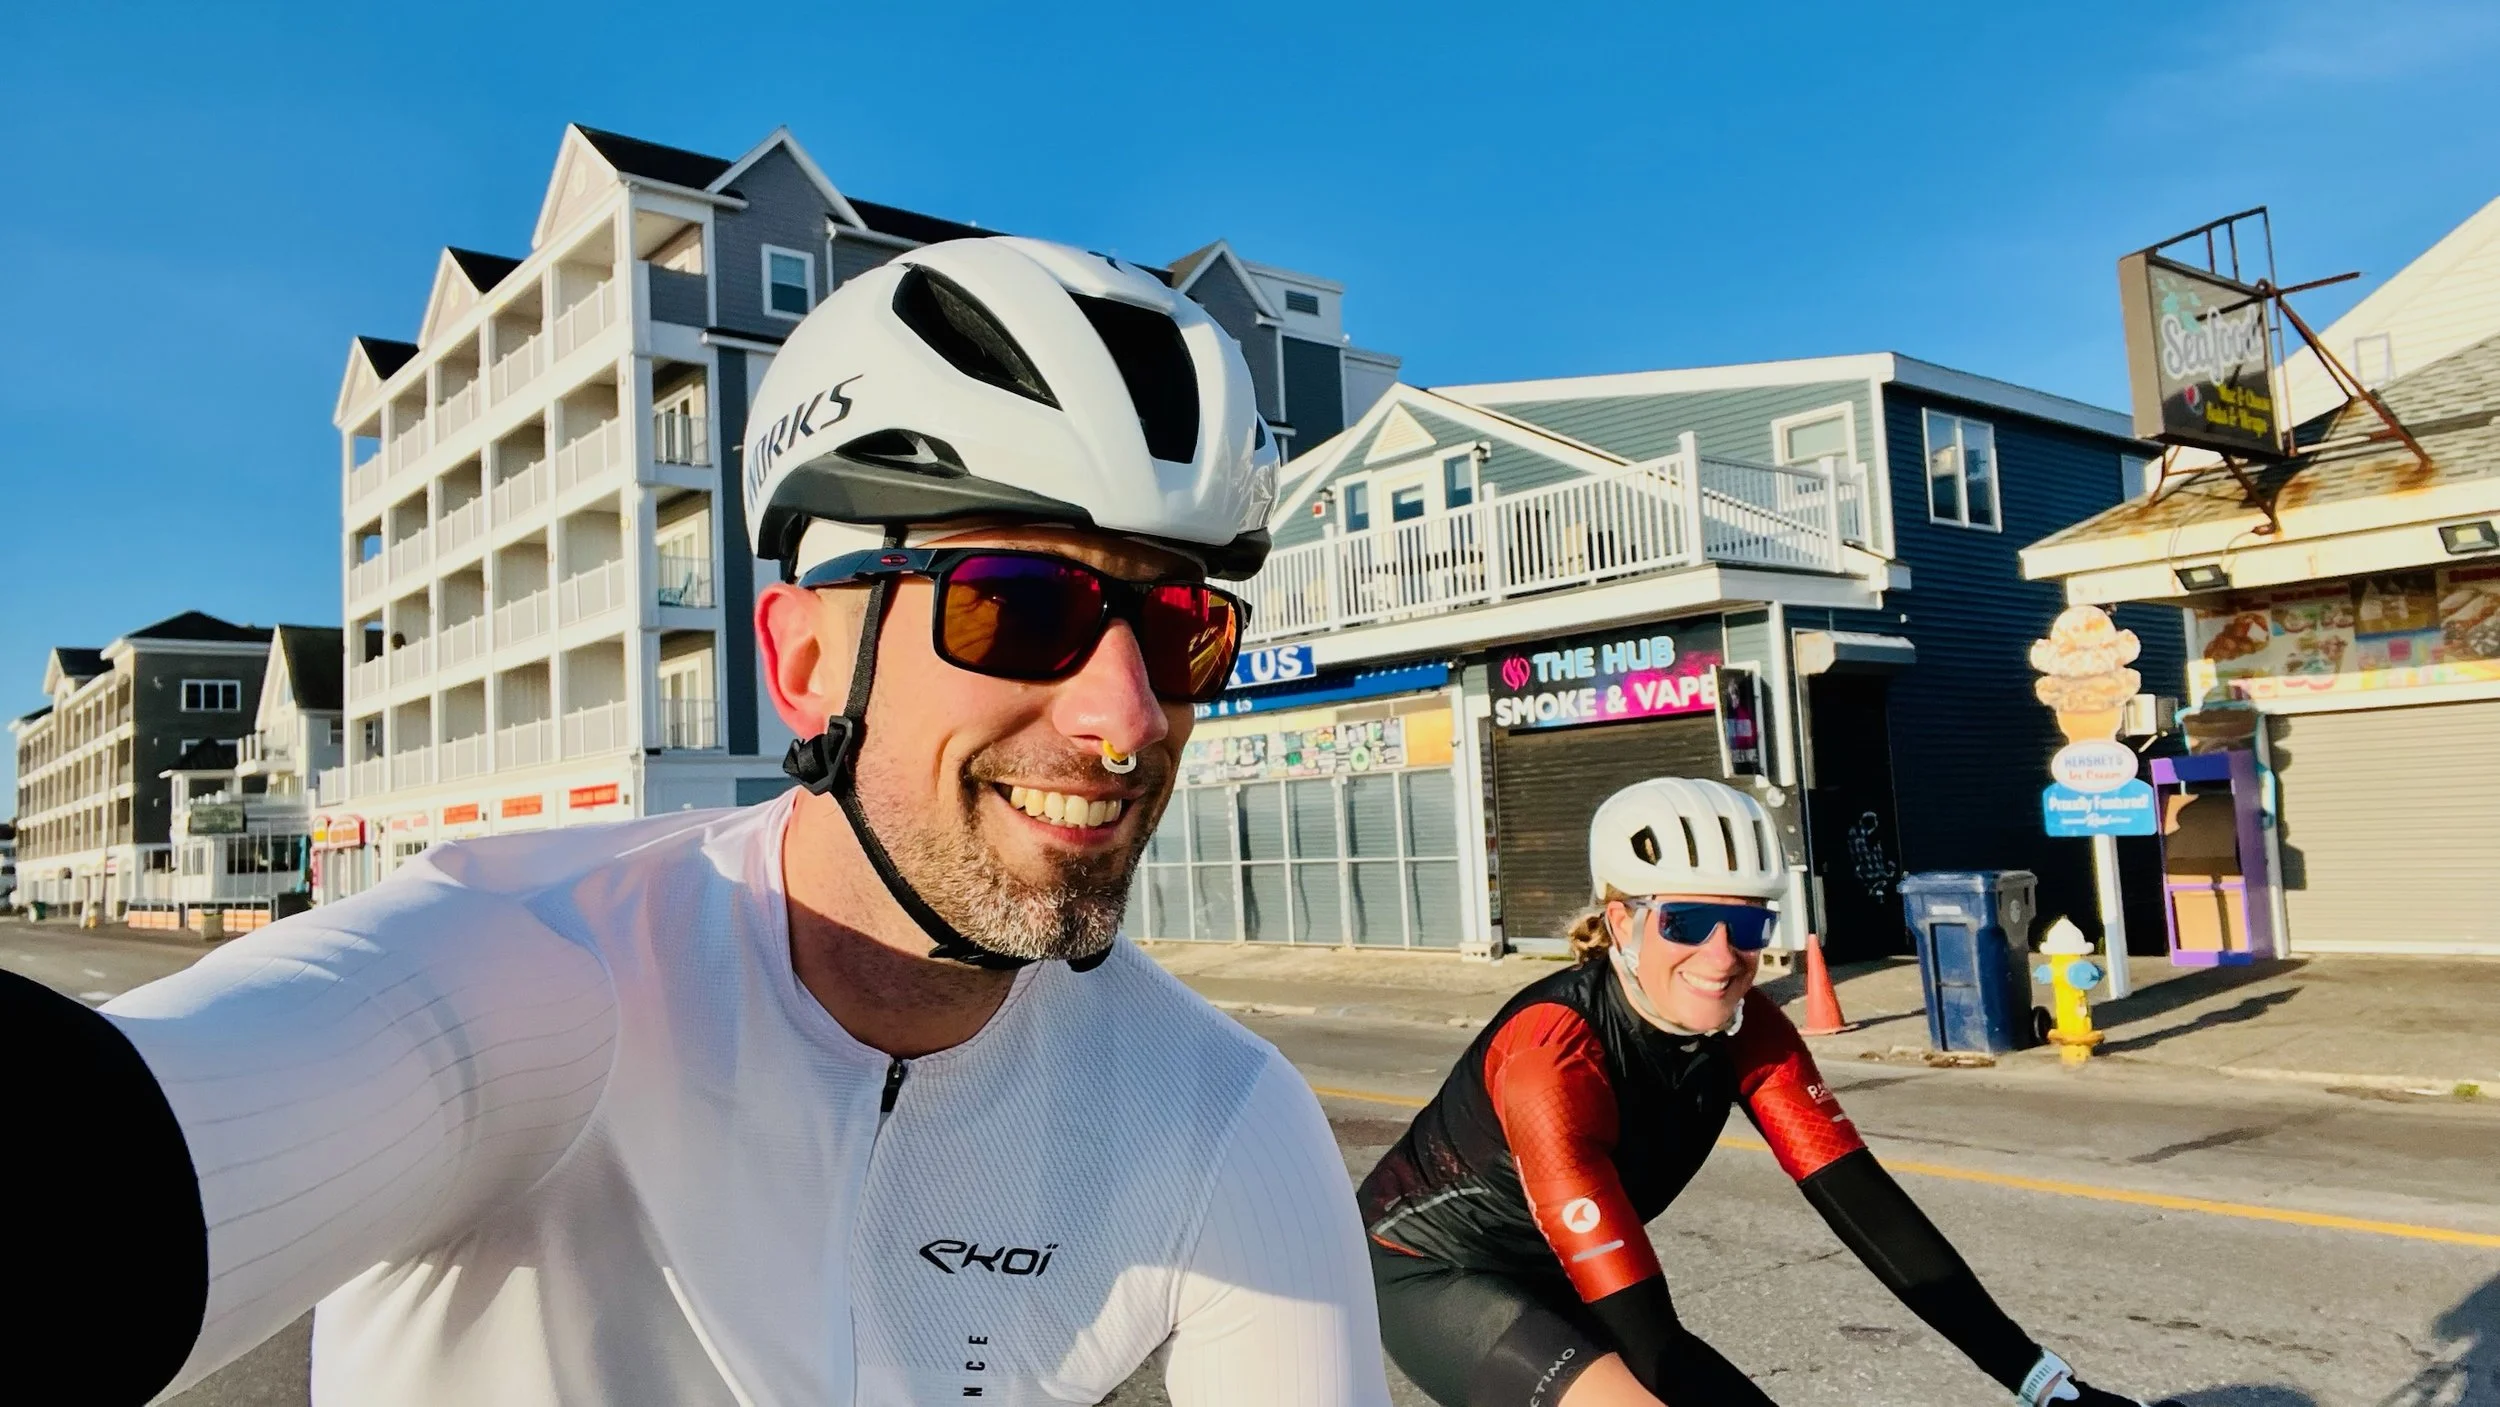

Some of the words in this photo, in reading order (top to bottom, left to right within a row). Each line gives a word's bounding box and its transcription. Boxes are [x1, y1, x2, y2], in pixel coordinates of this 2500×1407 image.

[2161, 304, 2263, 385] Seafood
[1251, 646, 1303, 681] US
[1532, 647, 1595, 683] THE
[1602, 635, 1675, 674] HUB
[1495, 687, 1597, 727] SMOKE
[1605, 685, 1627, 714] &
